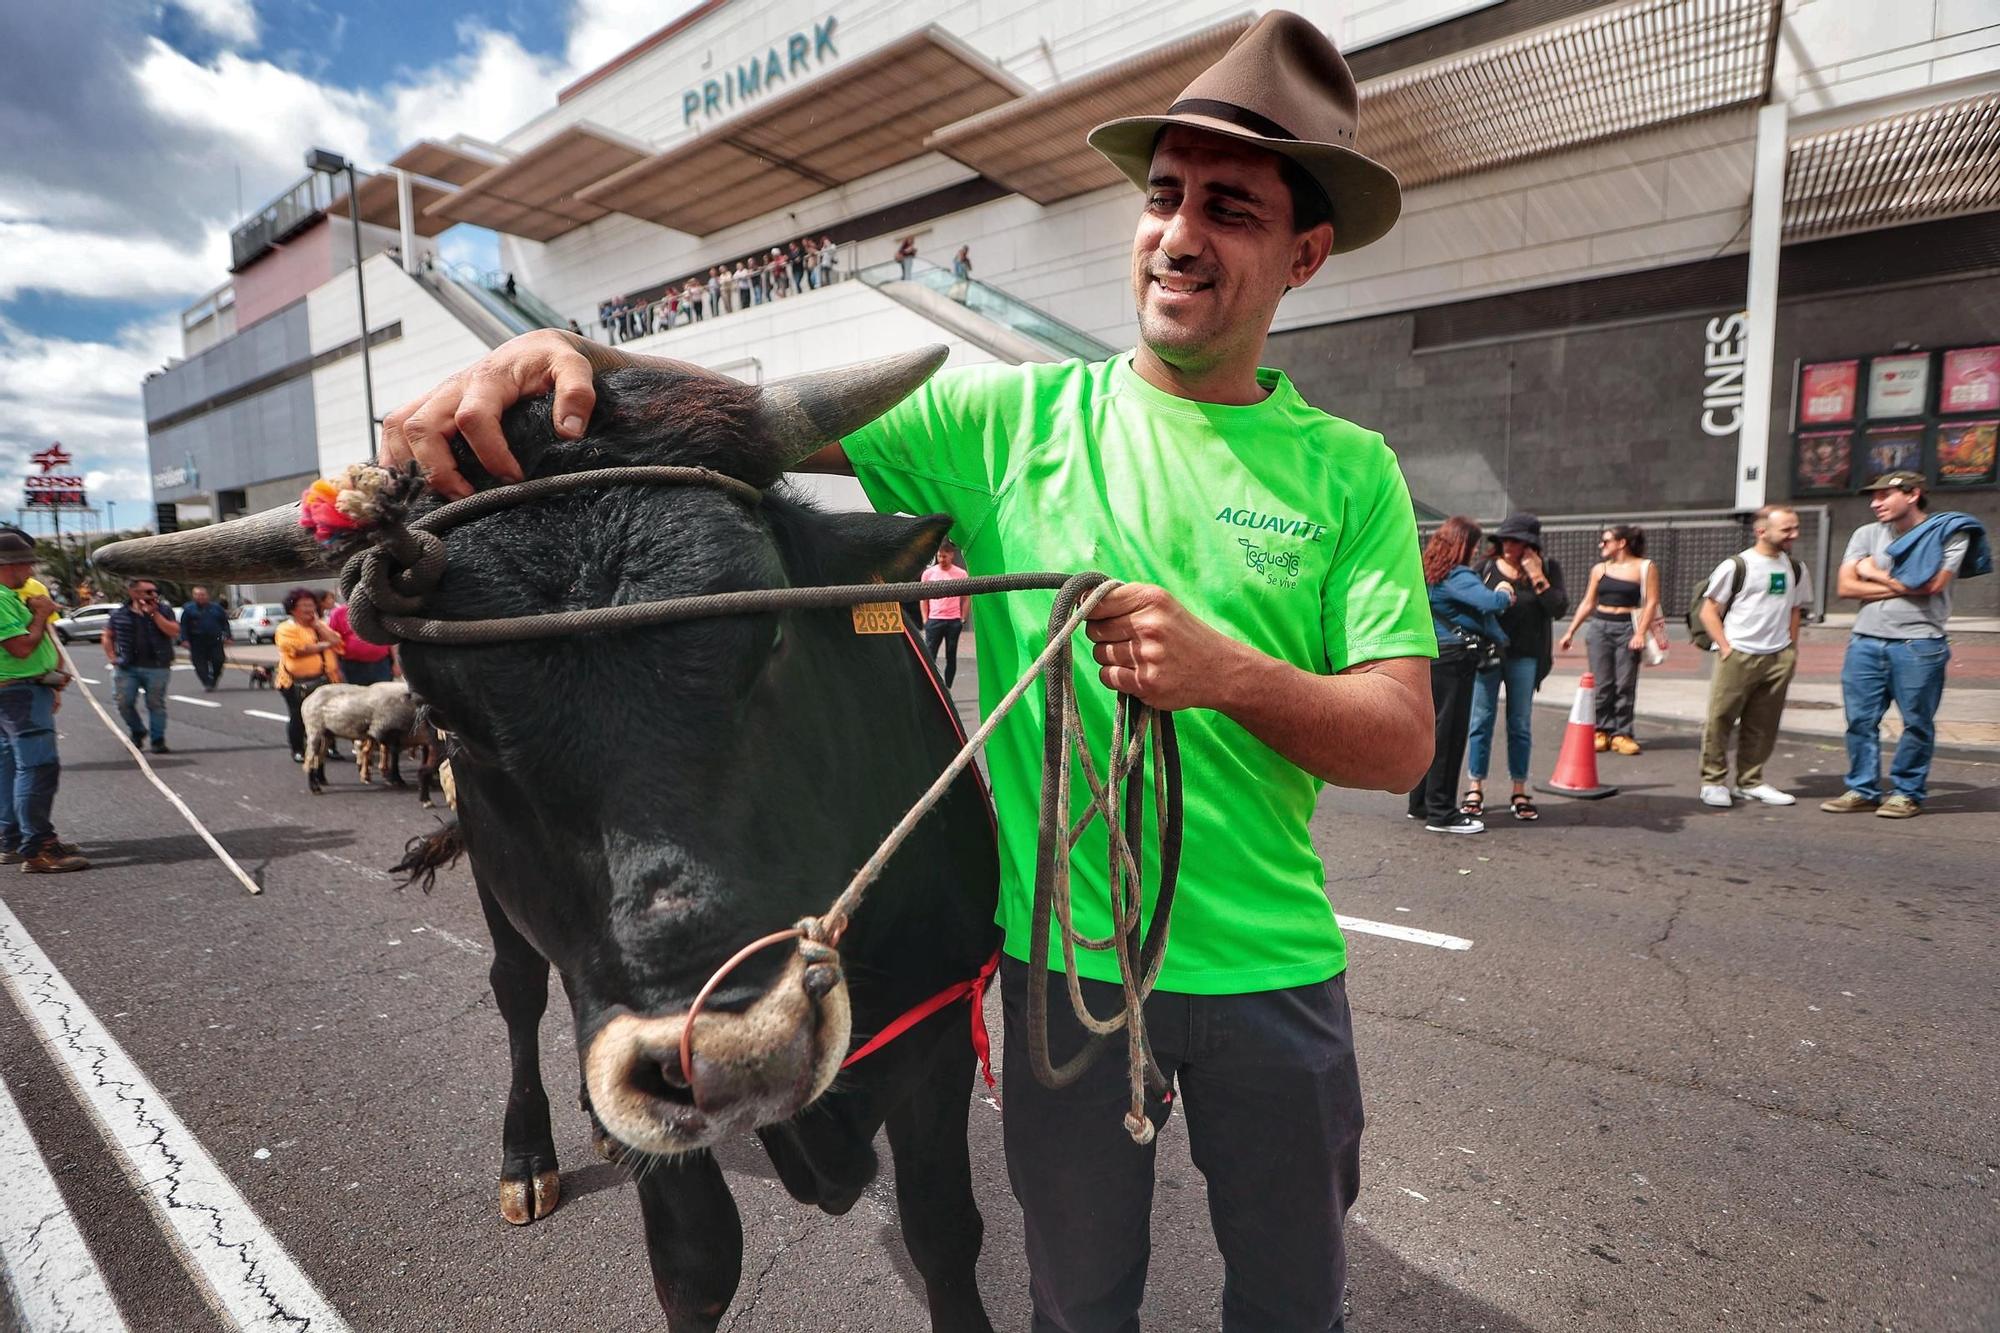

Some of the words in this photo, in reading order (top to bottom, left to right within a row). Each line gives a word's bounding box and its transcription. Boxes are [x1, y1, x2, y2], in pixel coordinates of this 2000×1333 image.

[683, 15, 838, 125] PRIMARK
[1701, 311, 1746, 436] CINES
[1216, 507, 1327, 542] AGUAVITE
[855, 612, 902, 631] 2032
